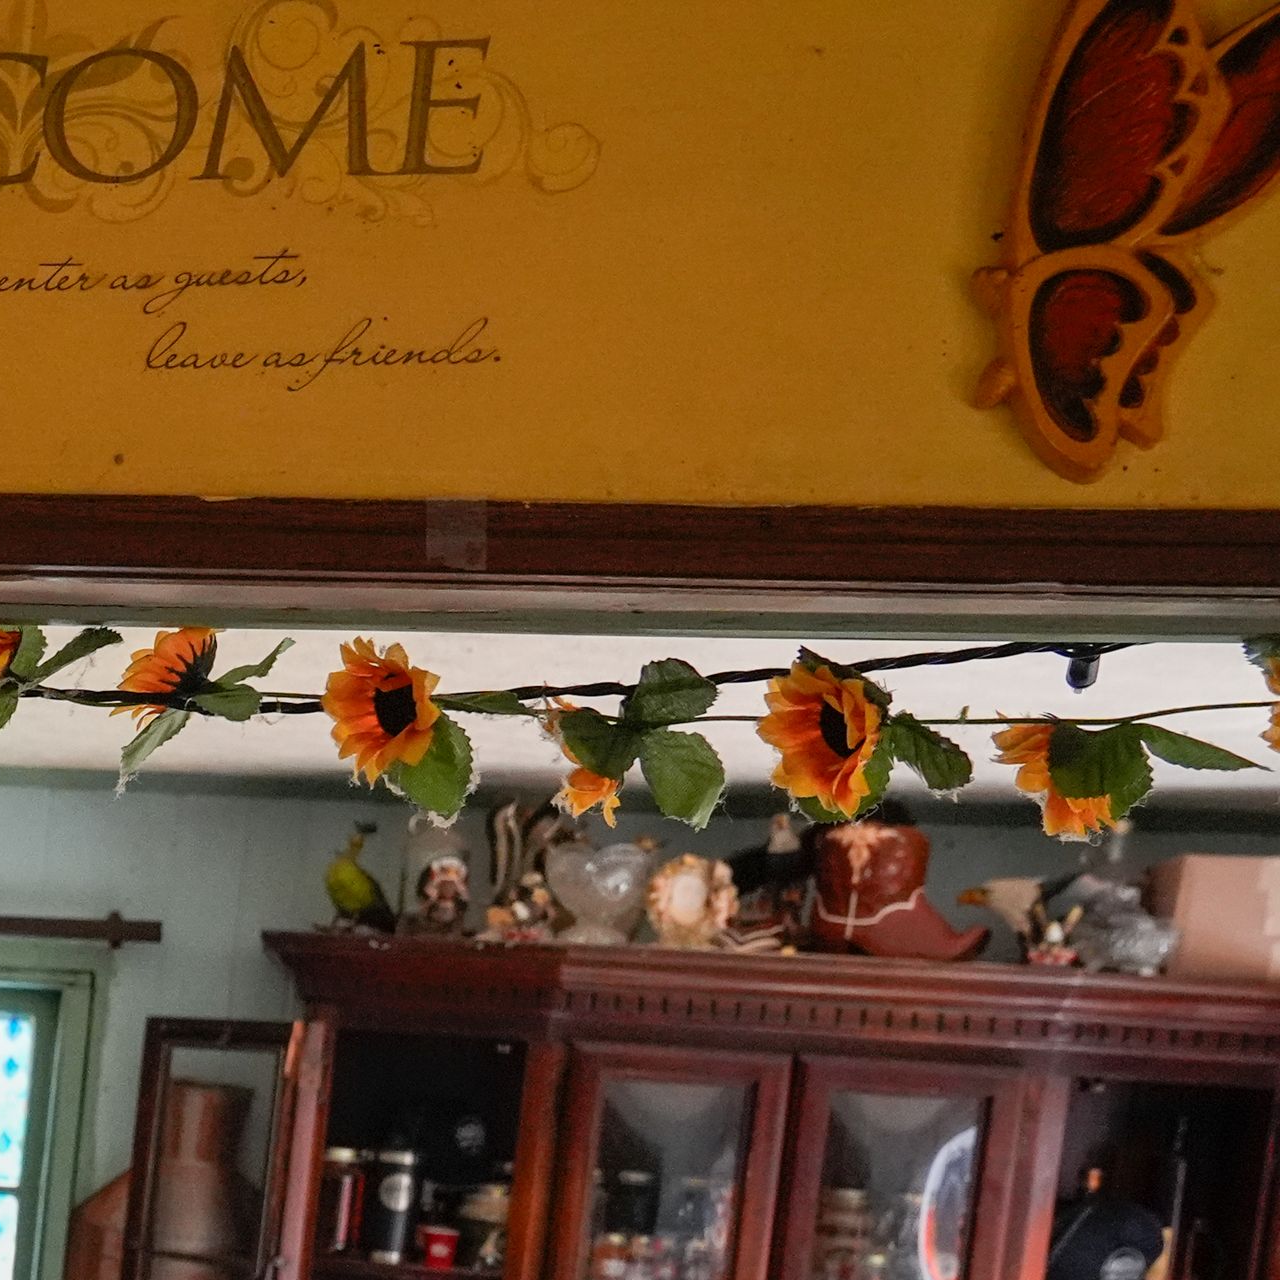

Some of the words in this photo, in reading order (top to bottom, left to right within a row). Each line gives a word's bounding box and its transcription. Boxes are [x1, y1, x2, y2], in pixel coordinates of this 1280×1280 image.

[110, 271, 165, 290] as
[143, 248, 307, 314] guests,
[145, 322, 257, 369] leave
[263, 349, 319, 368] as
[287, 317, 502, 392] friends.
